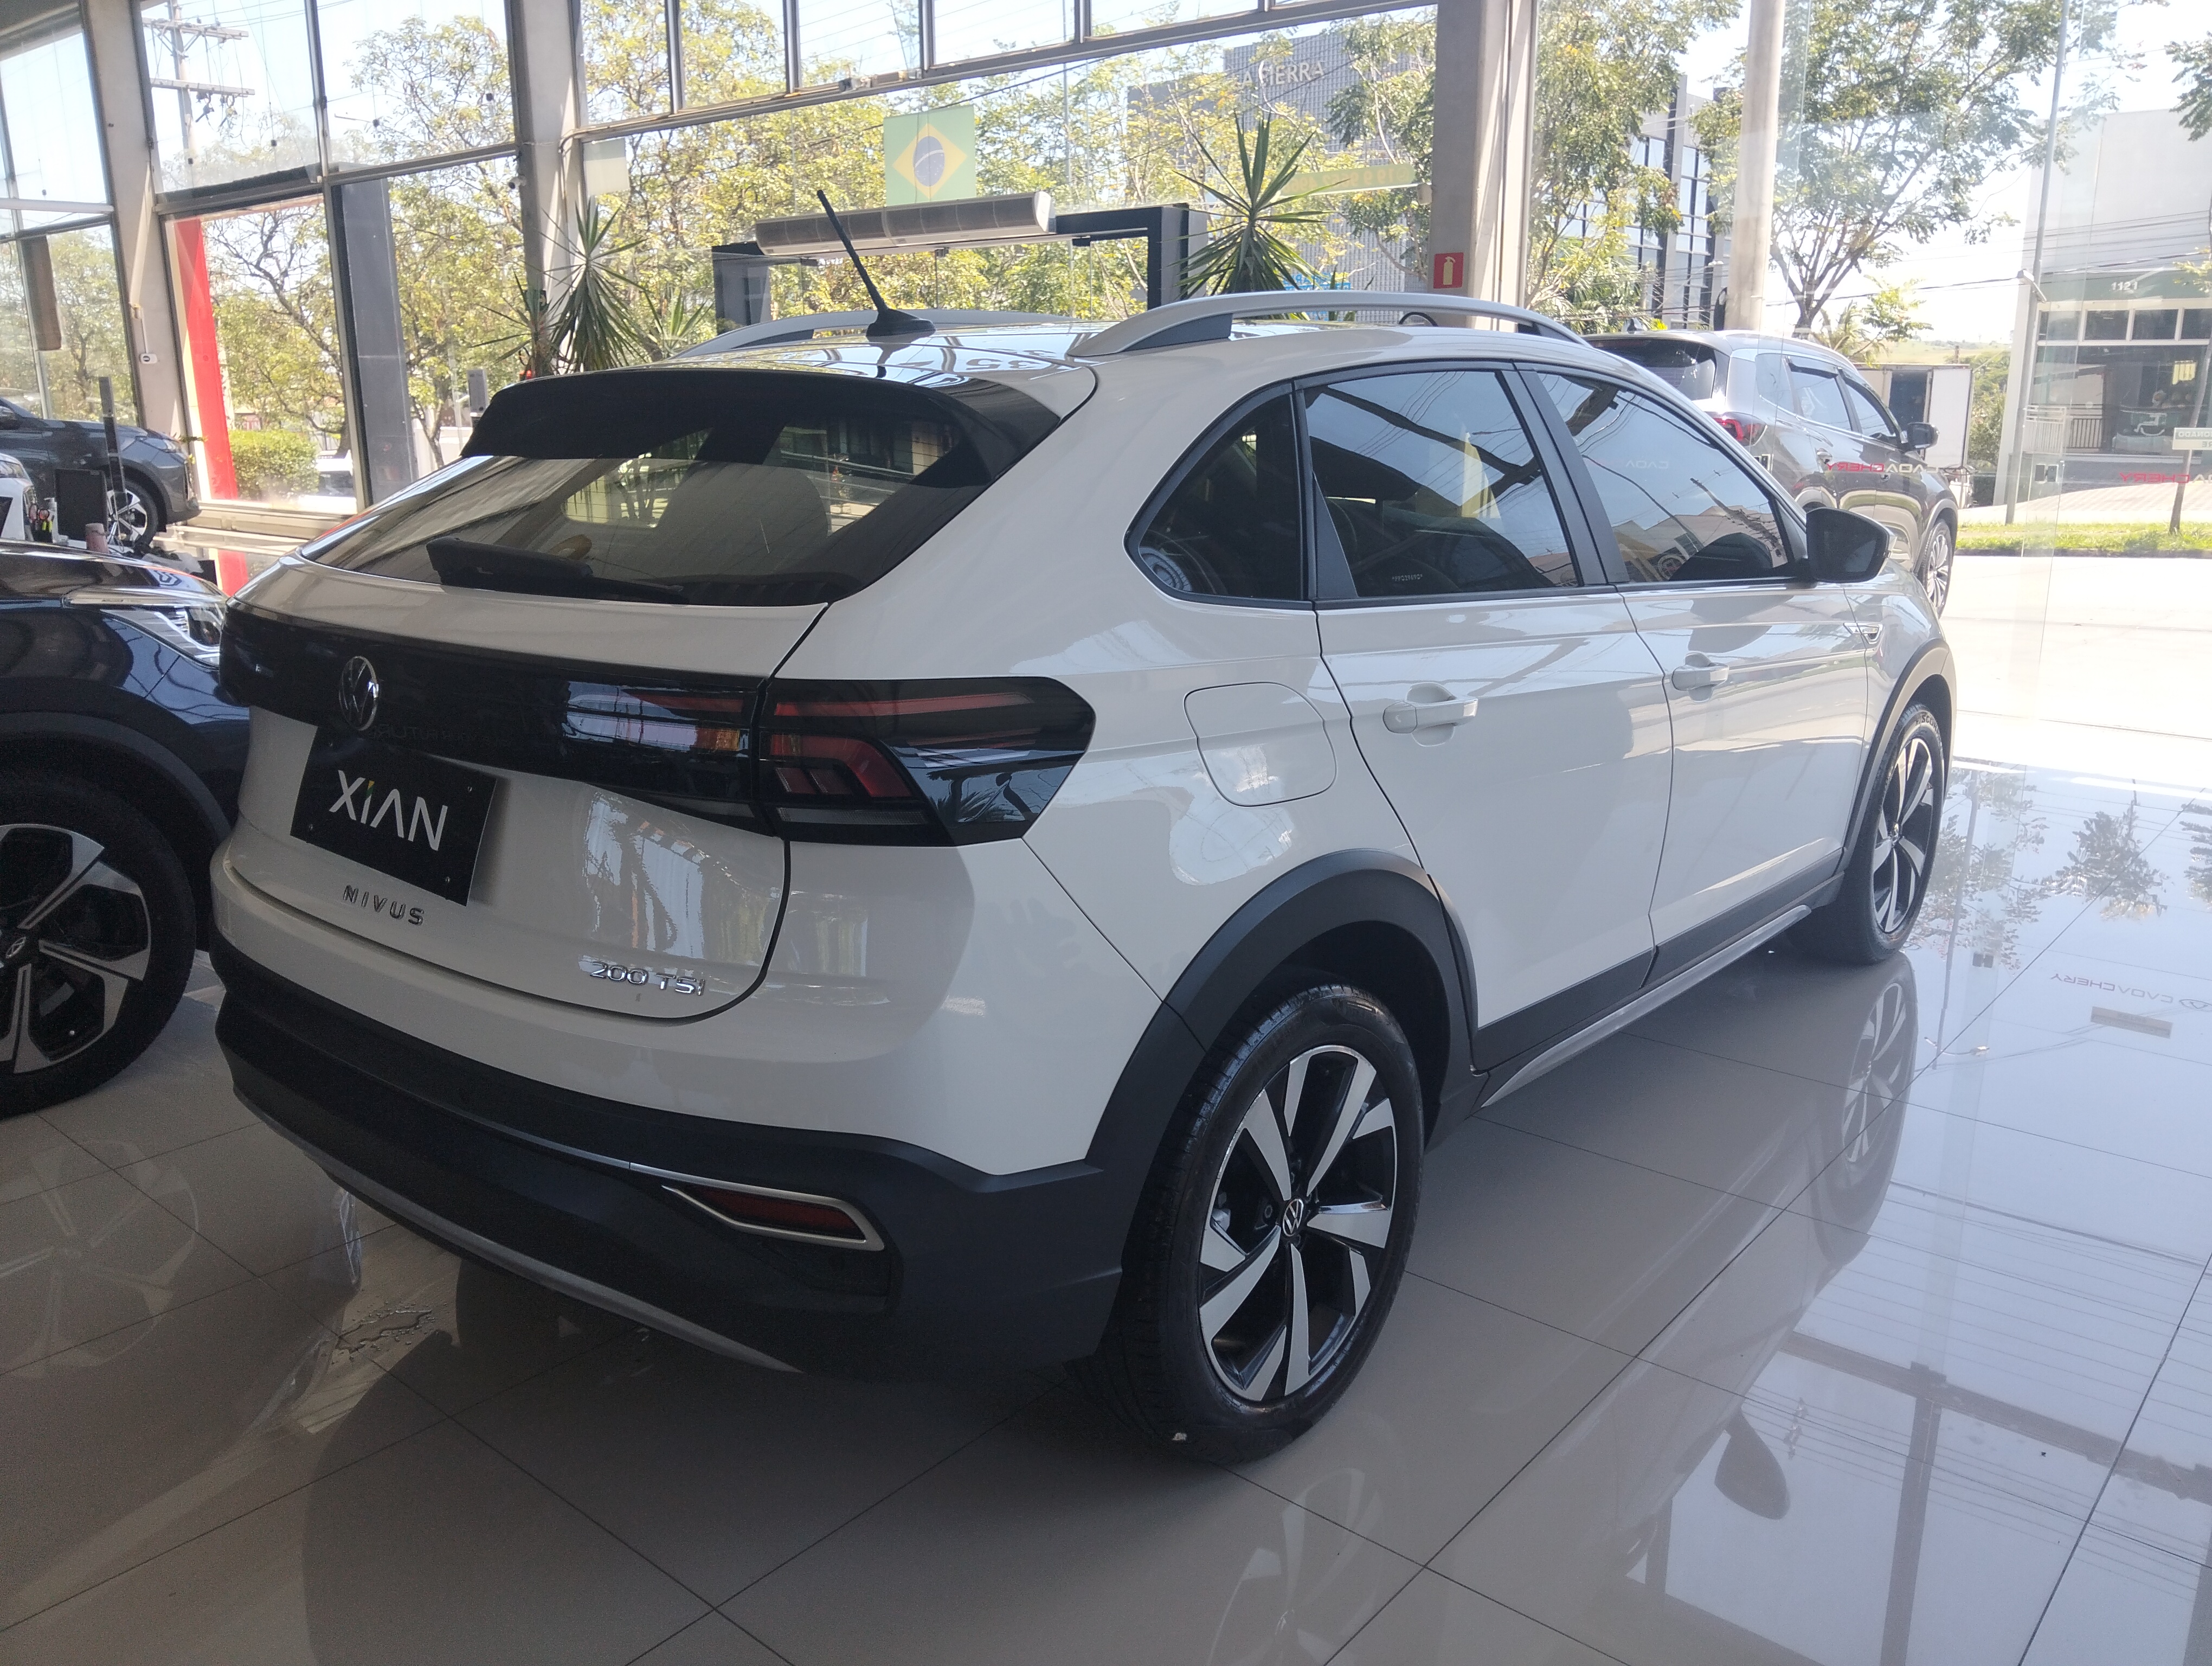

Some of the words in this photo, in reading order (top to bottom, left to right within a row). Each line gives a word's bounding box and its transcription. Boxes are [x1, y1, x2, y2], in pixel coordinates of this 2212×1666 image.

[2111, 281, 2138, 291] 1121
[329, 770, 448, 851] XIAN
[343, 885, 425, 926] NIVUS
[590, 962, 649, 985] 200
[655, 972, 705, 996] TSI
